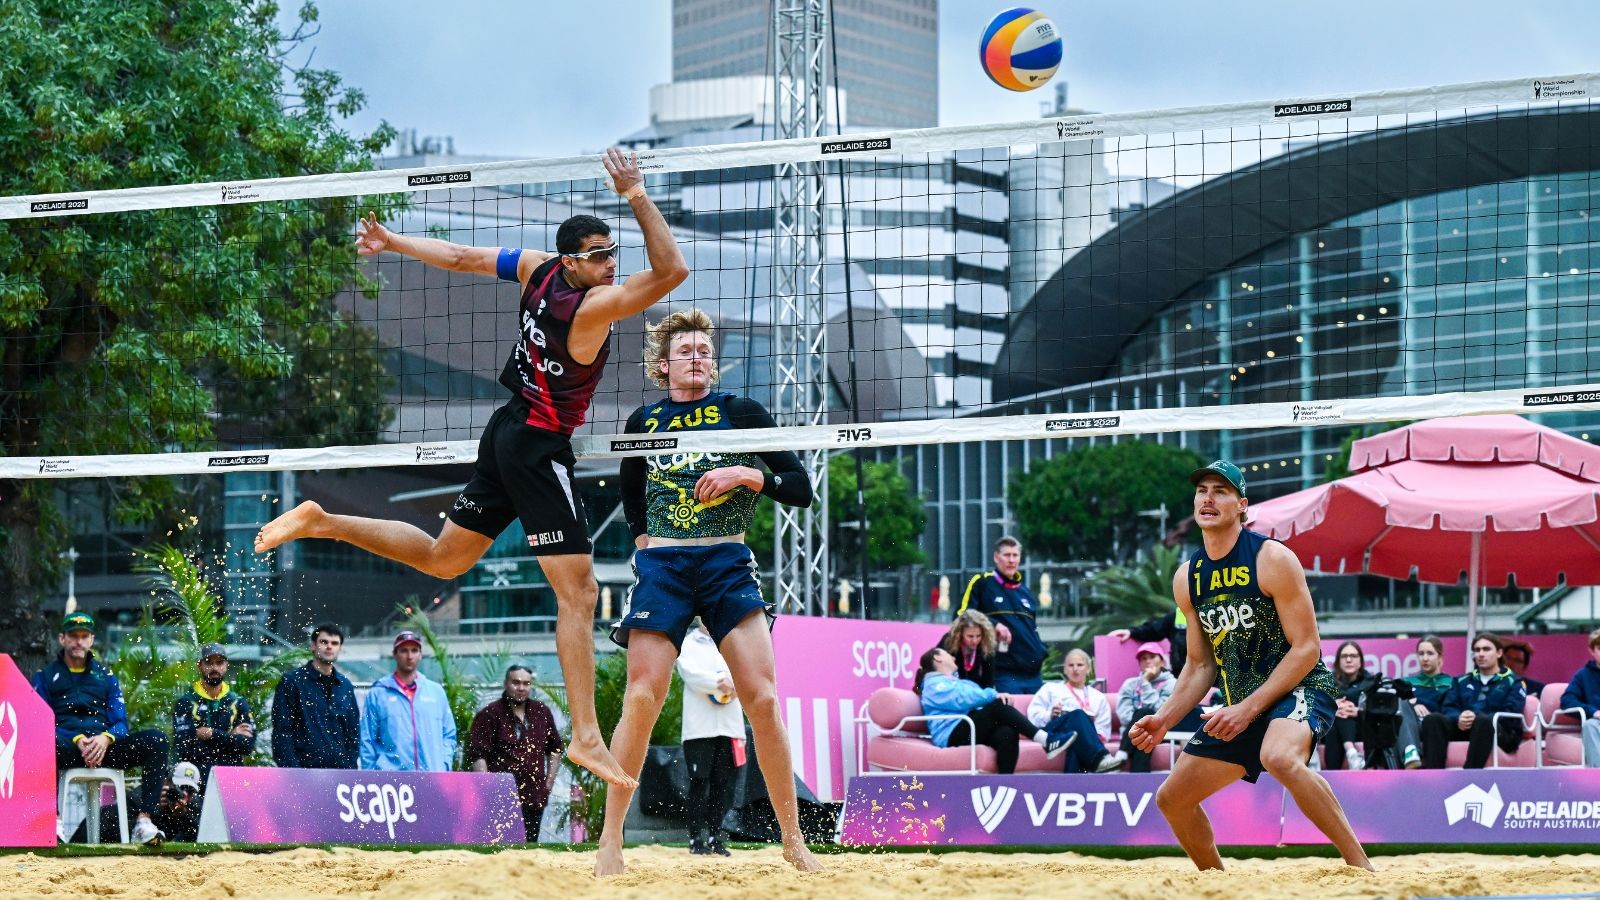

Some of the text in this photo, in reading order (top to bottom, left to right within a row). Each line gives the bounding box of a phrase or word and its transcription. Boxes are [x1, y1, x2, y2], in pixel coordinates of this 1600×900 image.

[1278, 103, 1348, 114] ADELAIDE 2025
[824, 141, 888, 152] ADELAIDE 2025
[410, 173, 469, 184] ADELAIDE 2025
[33, 203, 67, 211] ADELAIDE
[1528, 393, 1600, 404] ADELAIDE 2025
[667, 405, 721, 431] AUS
[1048, 419, 1117, 429] ADELAIDE 2025
[613, 440, 675, 450] ADELAIDE 2025
[210, 457, 246, 465] ADELAIDE
[539, 531, 564, 545] BELLO
[1193, 566, 1250, 595] 1 AUS
[1199, 604, 1256, 638] scape
[852, 640, 914, 688] scape
[336, 783, 418, 839] scape
[1023, 792, 1153, 827] VBTV
[1504, 801, 1600, 819] ADELAIDE
[1503, 820, 1600, 829] SOUTH AUSTRALIA
